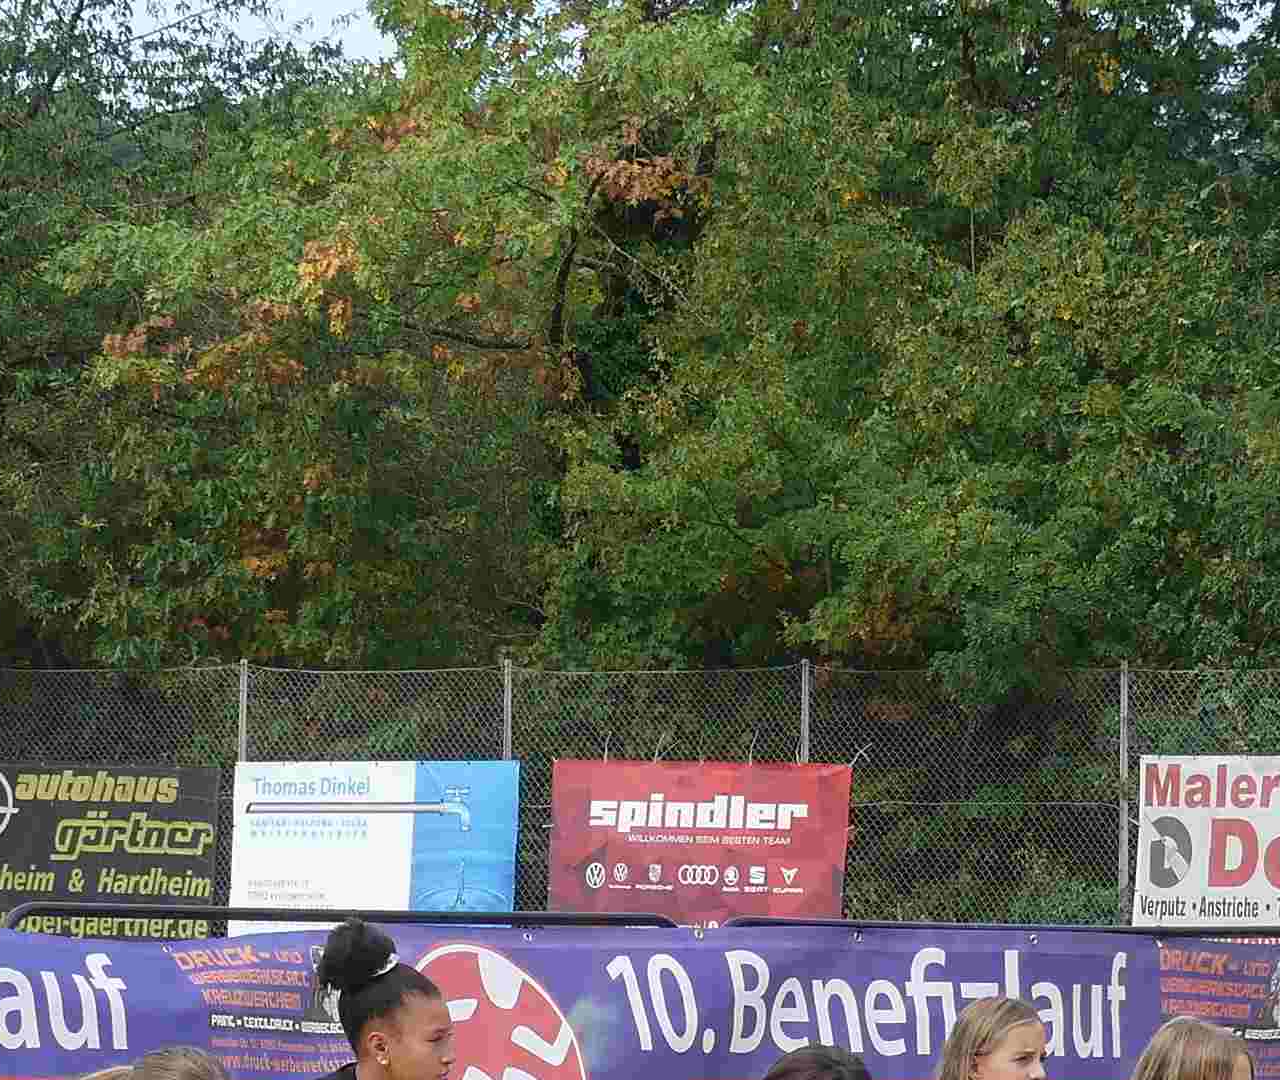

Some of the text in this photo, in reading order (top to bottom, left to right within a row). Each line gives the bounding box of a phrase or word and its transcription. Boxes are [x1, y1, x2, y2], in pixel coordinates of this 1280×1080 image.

[15, 770, 179, 803] autohaus
[254, 776, 370, 796] Thomas Dinkel
[589, 793, 809, 833] spindler
[50, 811, 214, 860] gärtner
[627, 832, 694, 844] WILLKOMMEN
[68, 868, 85, 892] &
[97, 867, 212, 898] Hardheim
[1140, 898, 1187, 920] Verputz
[1199, 897, 1260, 918] Anstriche
[606, 953, 716, 1054] 10.
